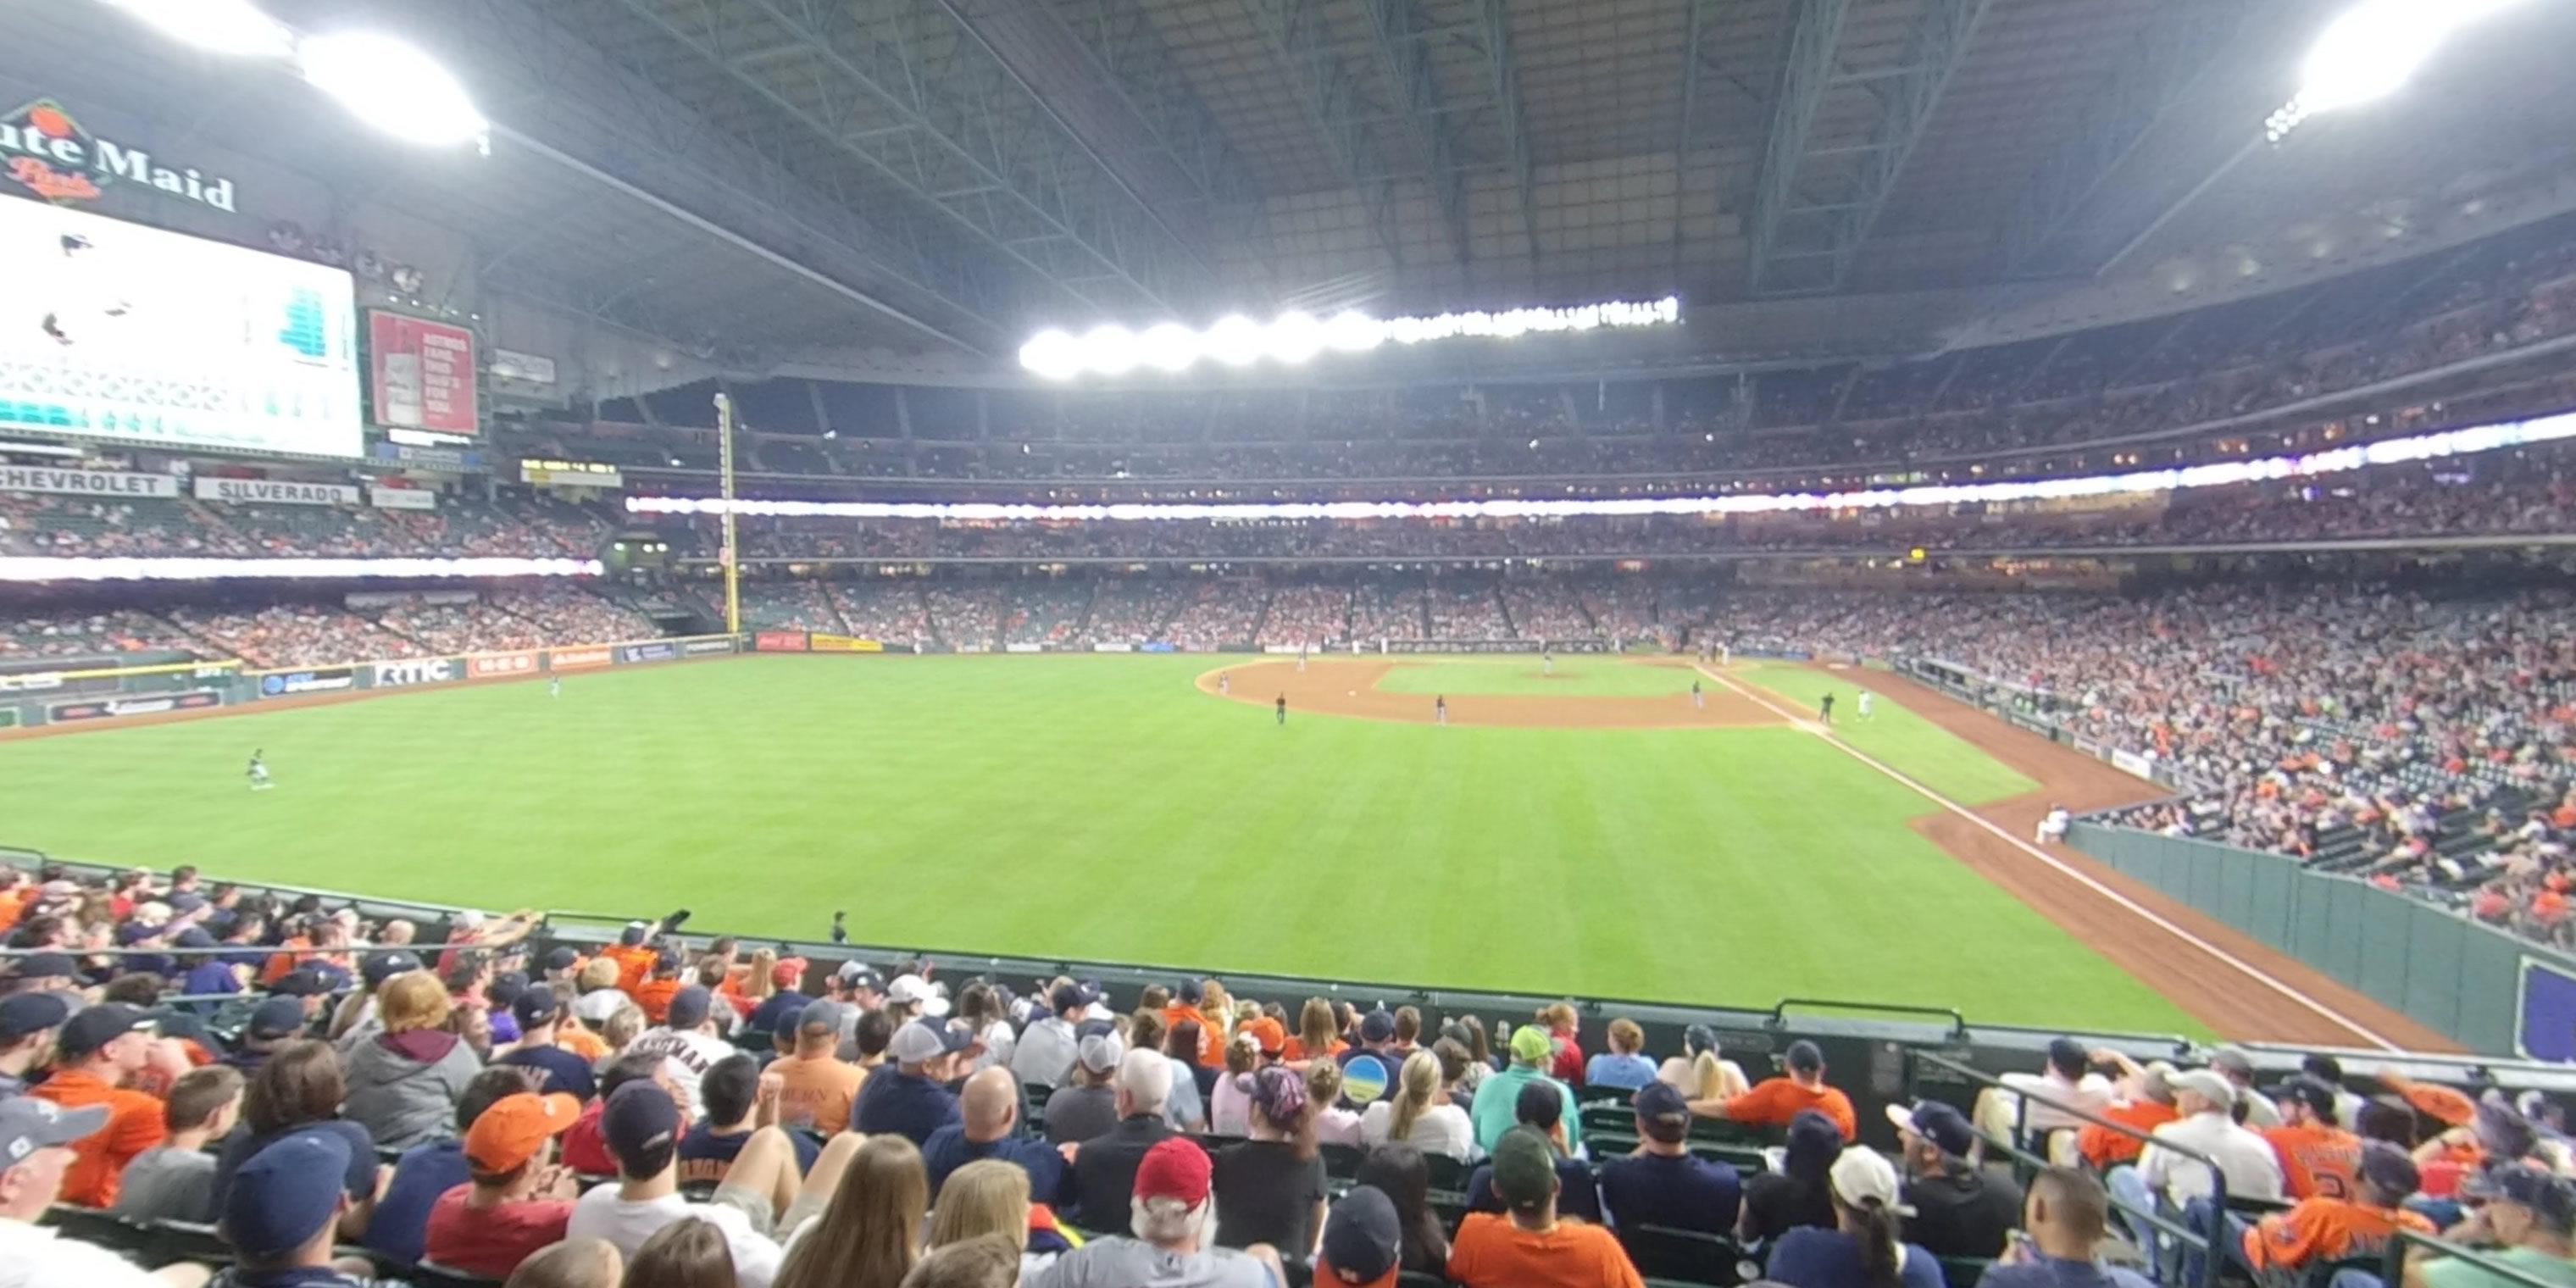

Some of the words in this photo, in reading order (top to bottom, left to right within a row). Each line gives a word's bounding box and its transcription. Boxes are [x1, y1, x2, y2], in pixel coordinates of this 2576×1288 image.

[95, 137, 236, 212] Maid
[0, 469, 158, 493] HEVROLET
[217, 481, 342, 502] SILVERADO
